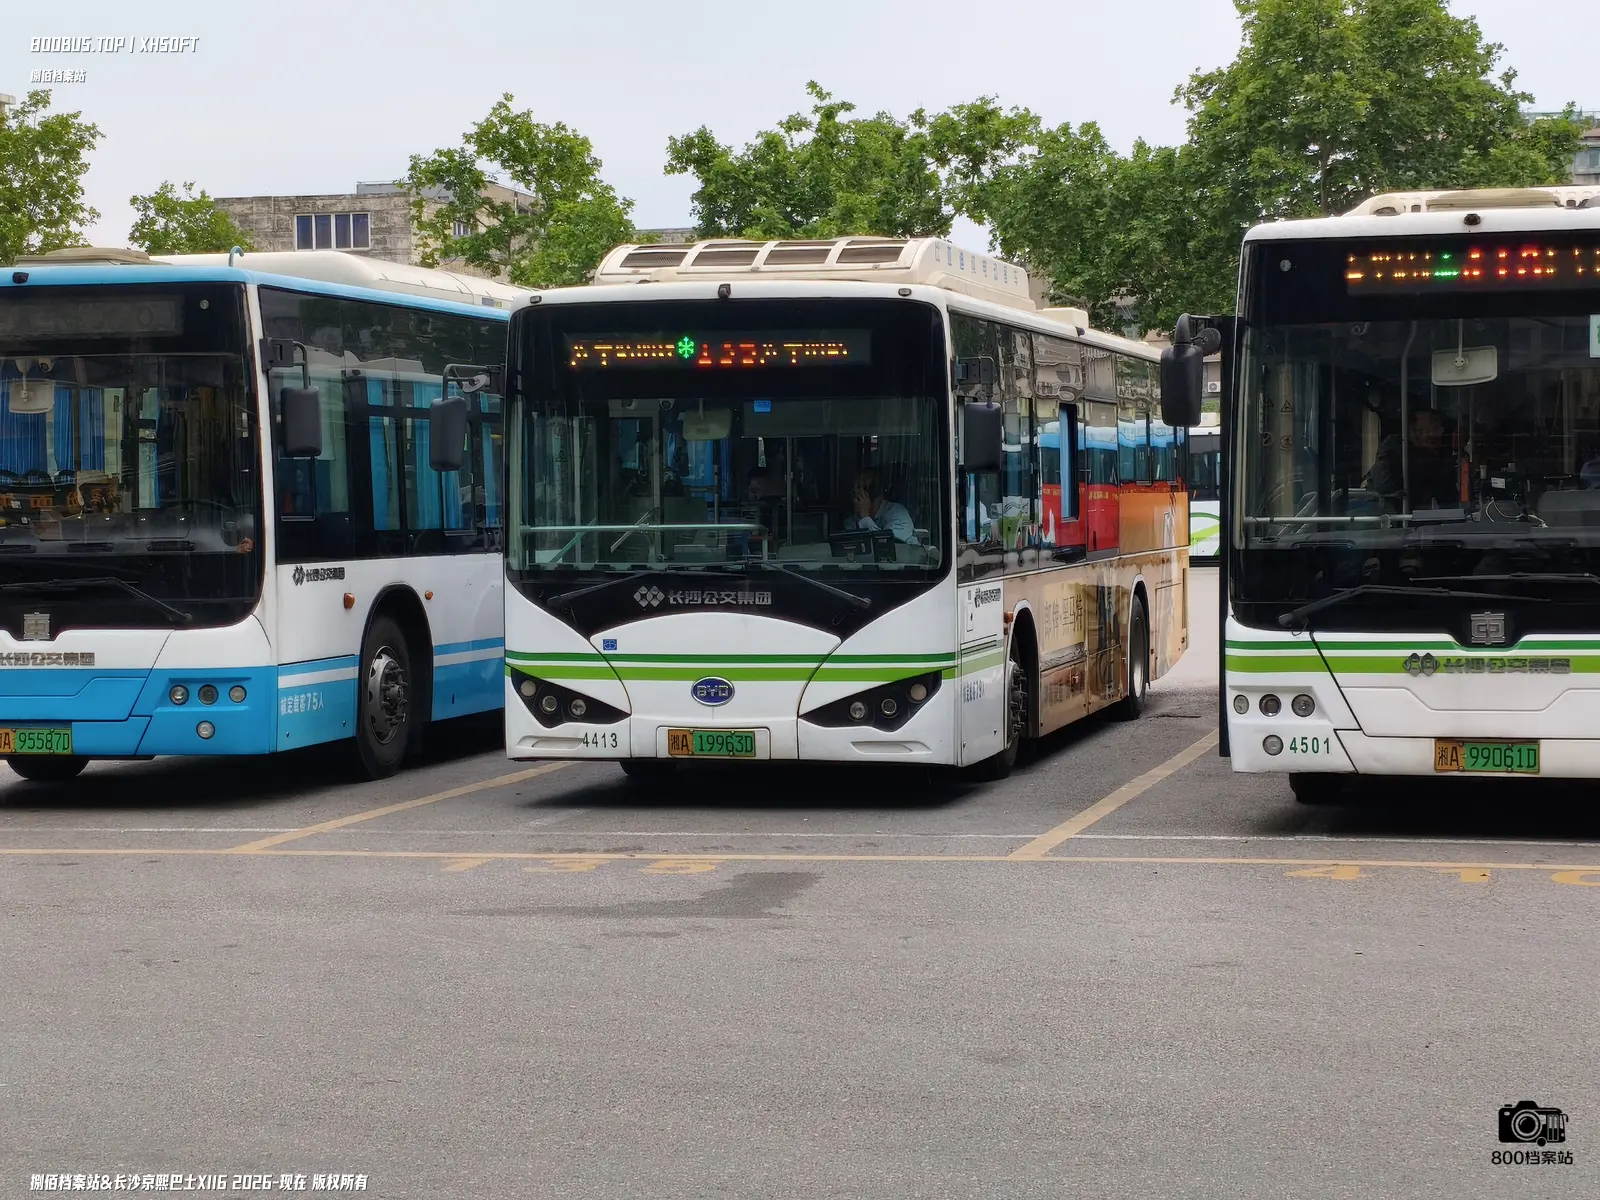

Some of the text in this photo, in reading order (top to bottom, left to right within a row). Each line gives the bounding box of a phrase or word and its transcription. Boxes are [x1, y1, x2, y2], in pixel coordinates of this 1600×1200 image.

[668, 590, 772, 605] 长沙公交集团
[697, 685, 730, 697] BYD
[582, 732, 618, 748] 4413
[1289, 737, 1331, 754] 4501
